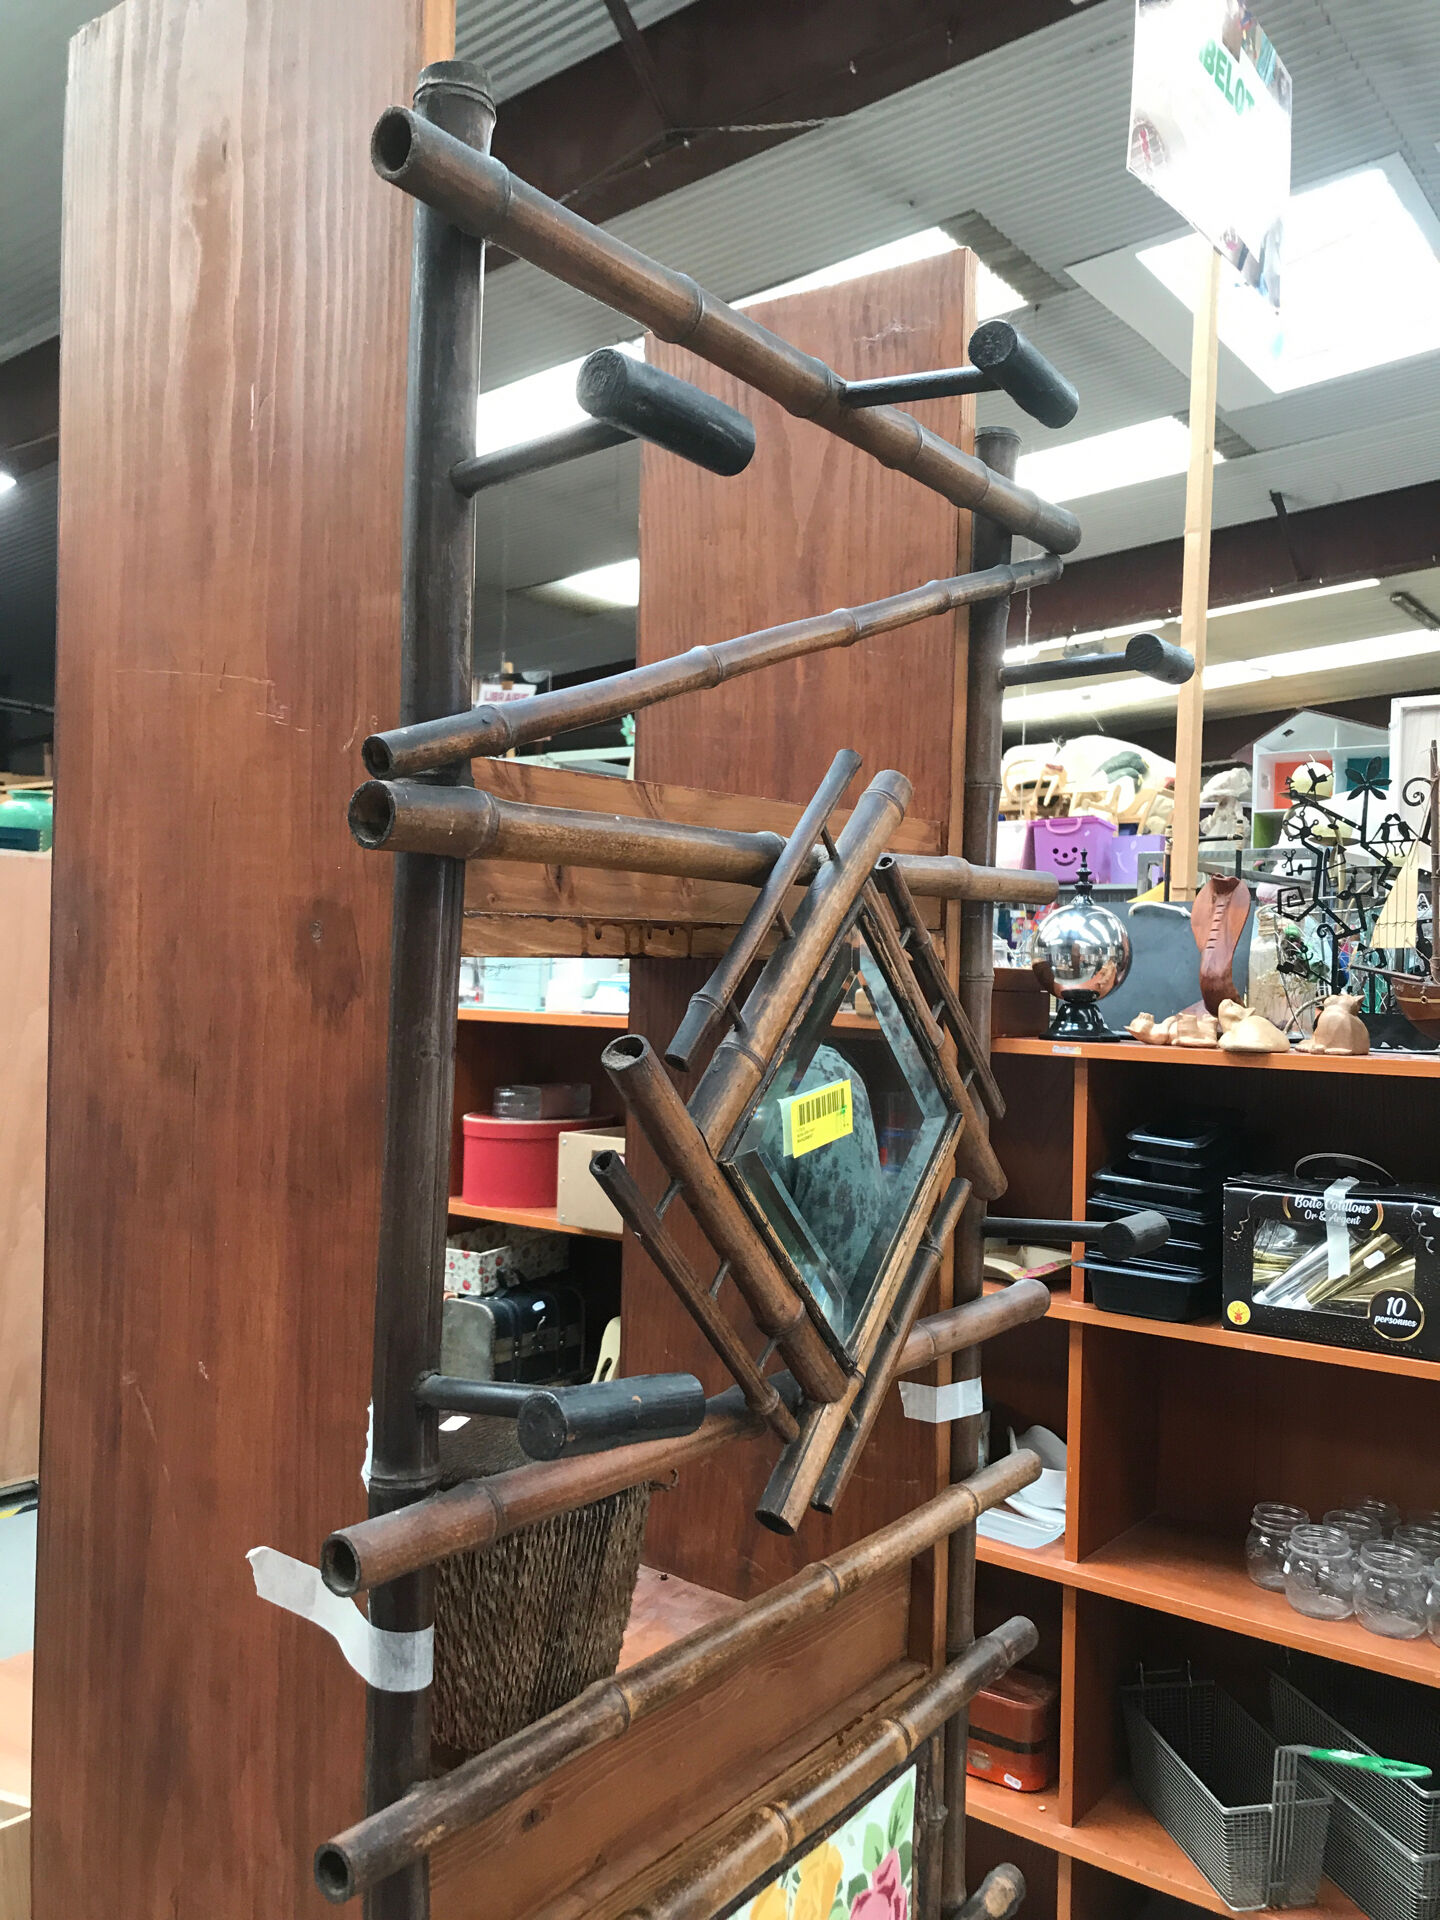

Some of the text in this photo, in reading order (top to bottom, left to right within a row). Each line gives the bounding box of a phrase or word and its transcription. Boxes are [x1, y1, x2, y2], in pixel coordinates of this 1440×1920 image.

[1304, 1209, 1318, 1220] Or
[1318, 1210, 1327, 1222] &
[1387, 1296, 1407, 1317] 10
[1373, 1315, 1418, 1328] personnes
